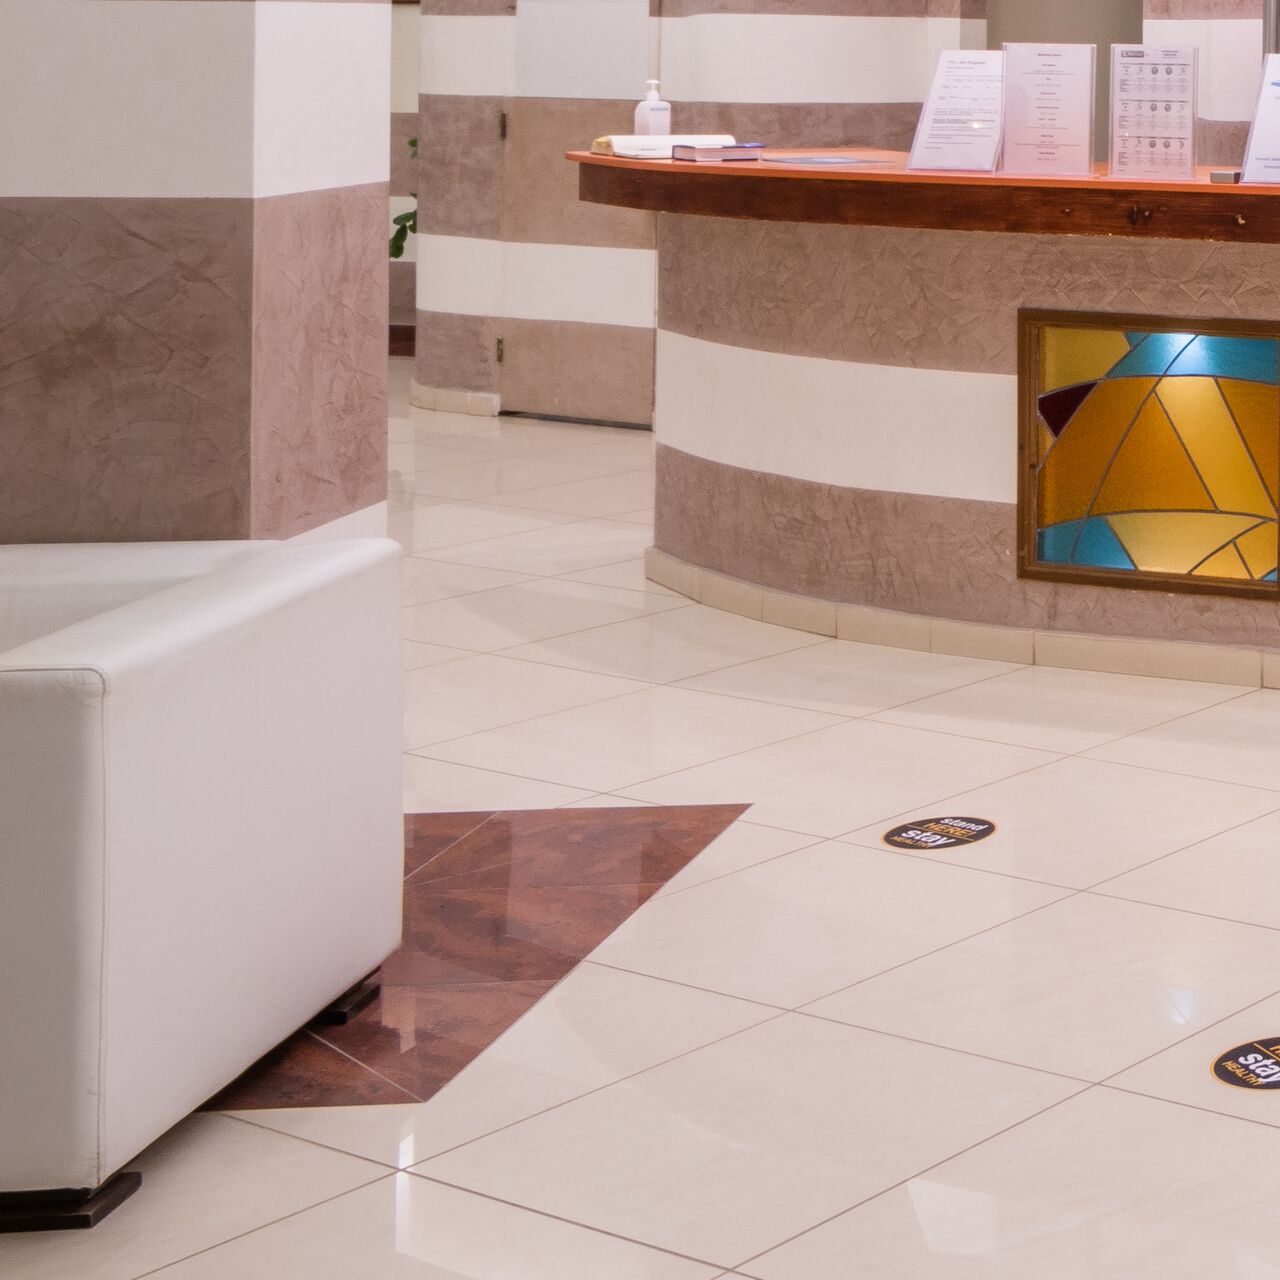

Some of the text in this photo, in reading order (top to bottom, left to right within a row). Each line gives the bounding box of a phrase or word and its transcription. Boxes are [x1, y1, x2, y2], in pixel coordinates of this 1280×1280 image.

[923, 823, 977, 837] HERE!
[940, 818, 988, 831] stand
[901, 830, 956, 846] stay
[1221, 1060, 1266, 1087] HEALTHY
